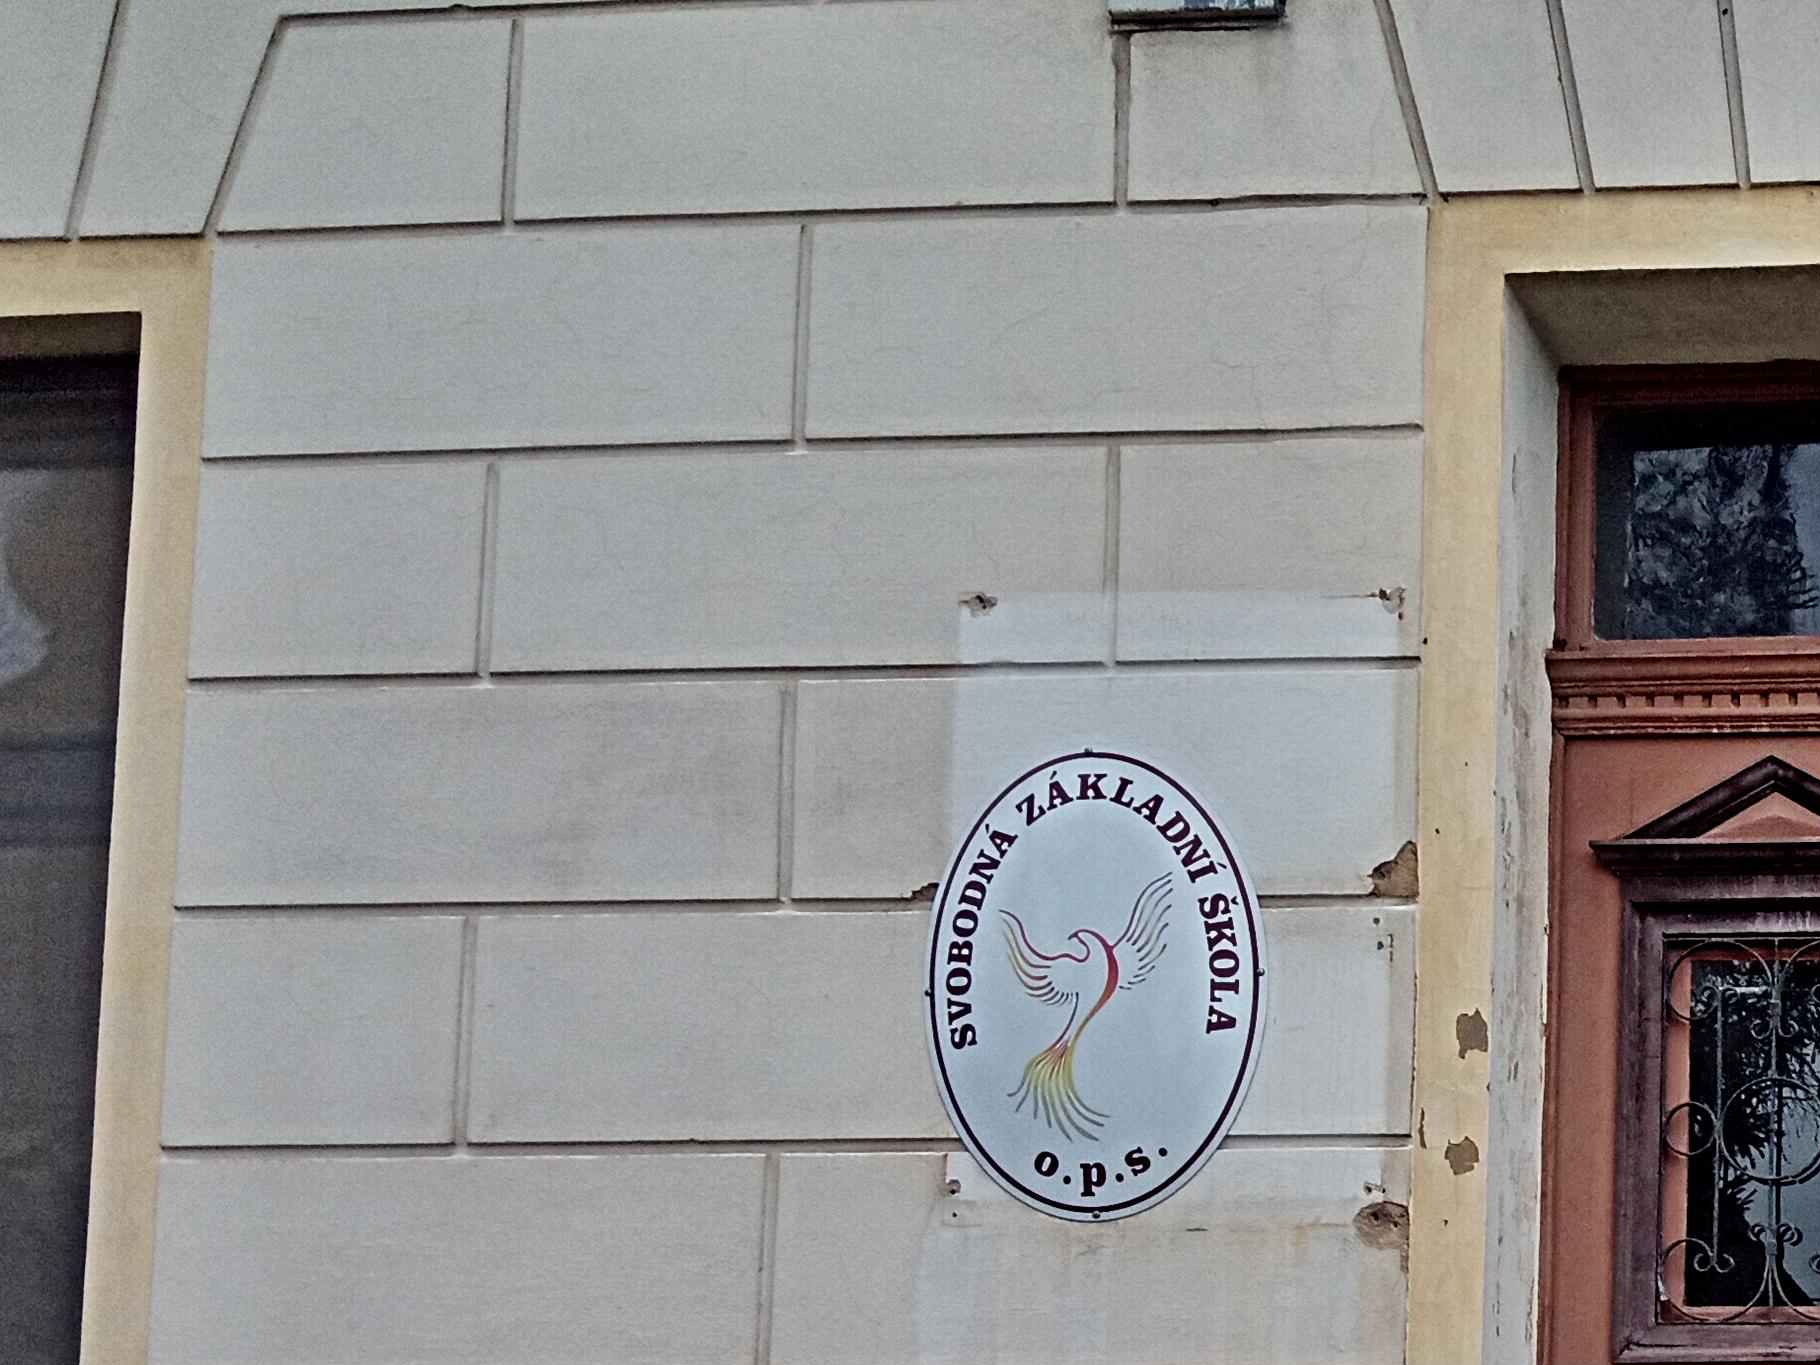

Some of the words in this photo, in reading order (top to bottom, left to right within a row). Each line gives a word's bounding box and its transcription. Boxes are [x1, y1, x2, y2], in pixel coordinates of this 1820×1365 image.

[946, 824, 1018, 1050] SVOBODNÁ
[1016, 770, 1227, 884] ZÁKLADNÍ
[1198, 895, 1240, 1034] ŠKOLA
[1033, 1145, 1169, 1197] o.p.s.
